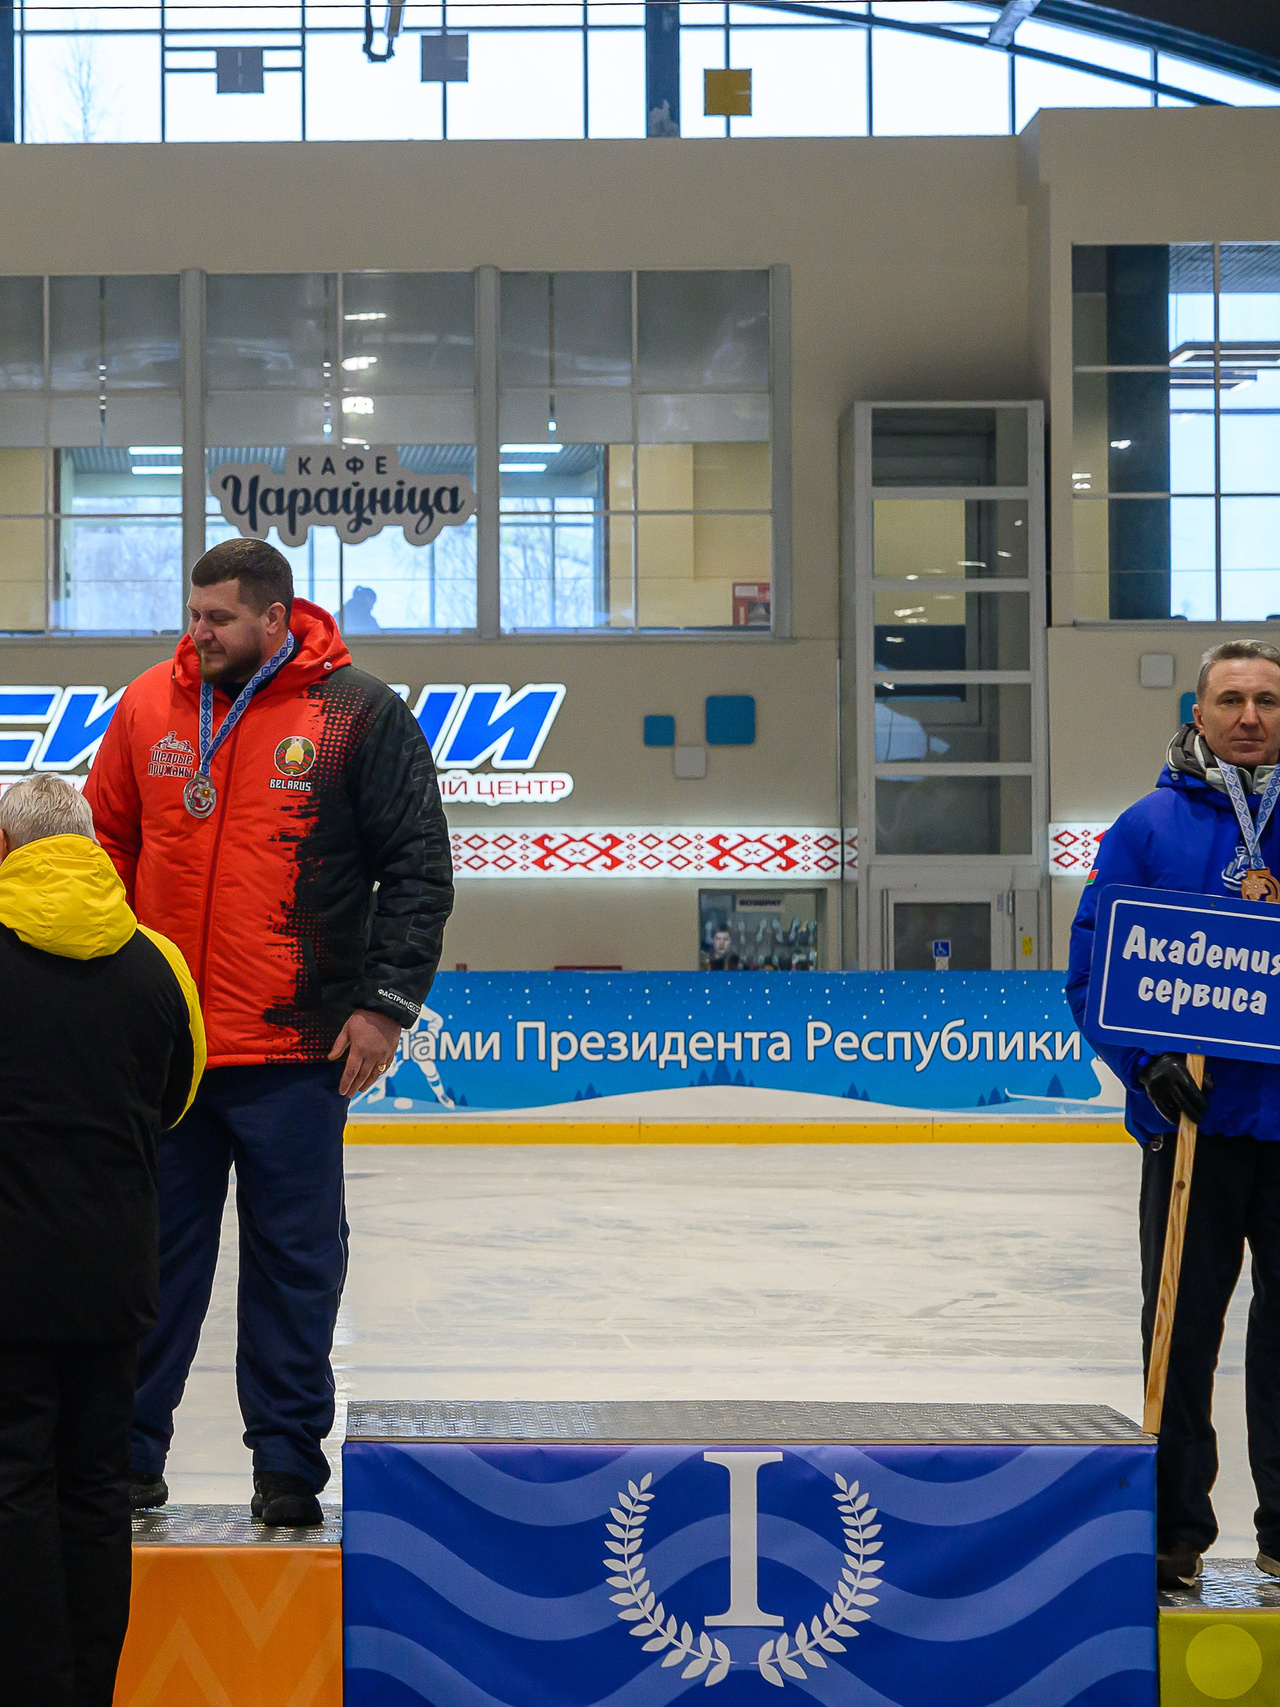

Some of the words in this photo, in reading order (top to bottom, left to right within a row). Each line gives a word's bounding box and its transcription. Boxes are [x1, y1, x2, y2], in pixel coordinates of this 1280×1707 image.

[297, 456, 388, 475] КАФЕ
[221, 475, 465, 536] Чараўніца
[151, 750, 194, 766] Щедрые
[148, 763, 194, 778] Пружаны
[269, 779, 312, 792] BELARUS
[476, 780, 566, 798] ЦЕНТР
[1137, 976, 1268, 1016] сервиса
[516, 1020, 792, 1071] Президента
[806, 1018, 1082, 1073] Республики
